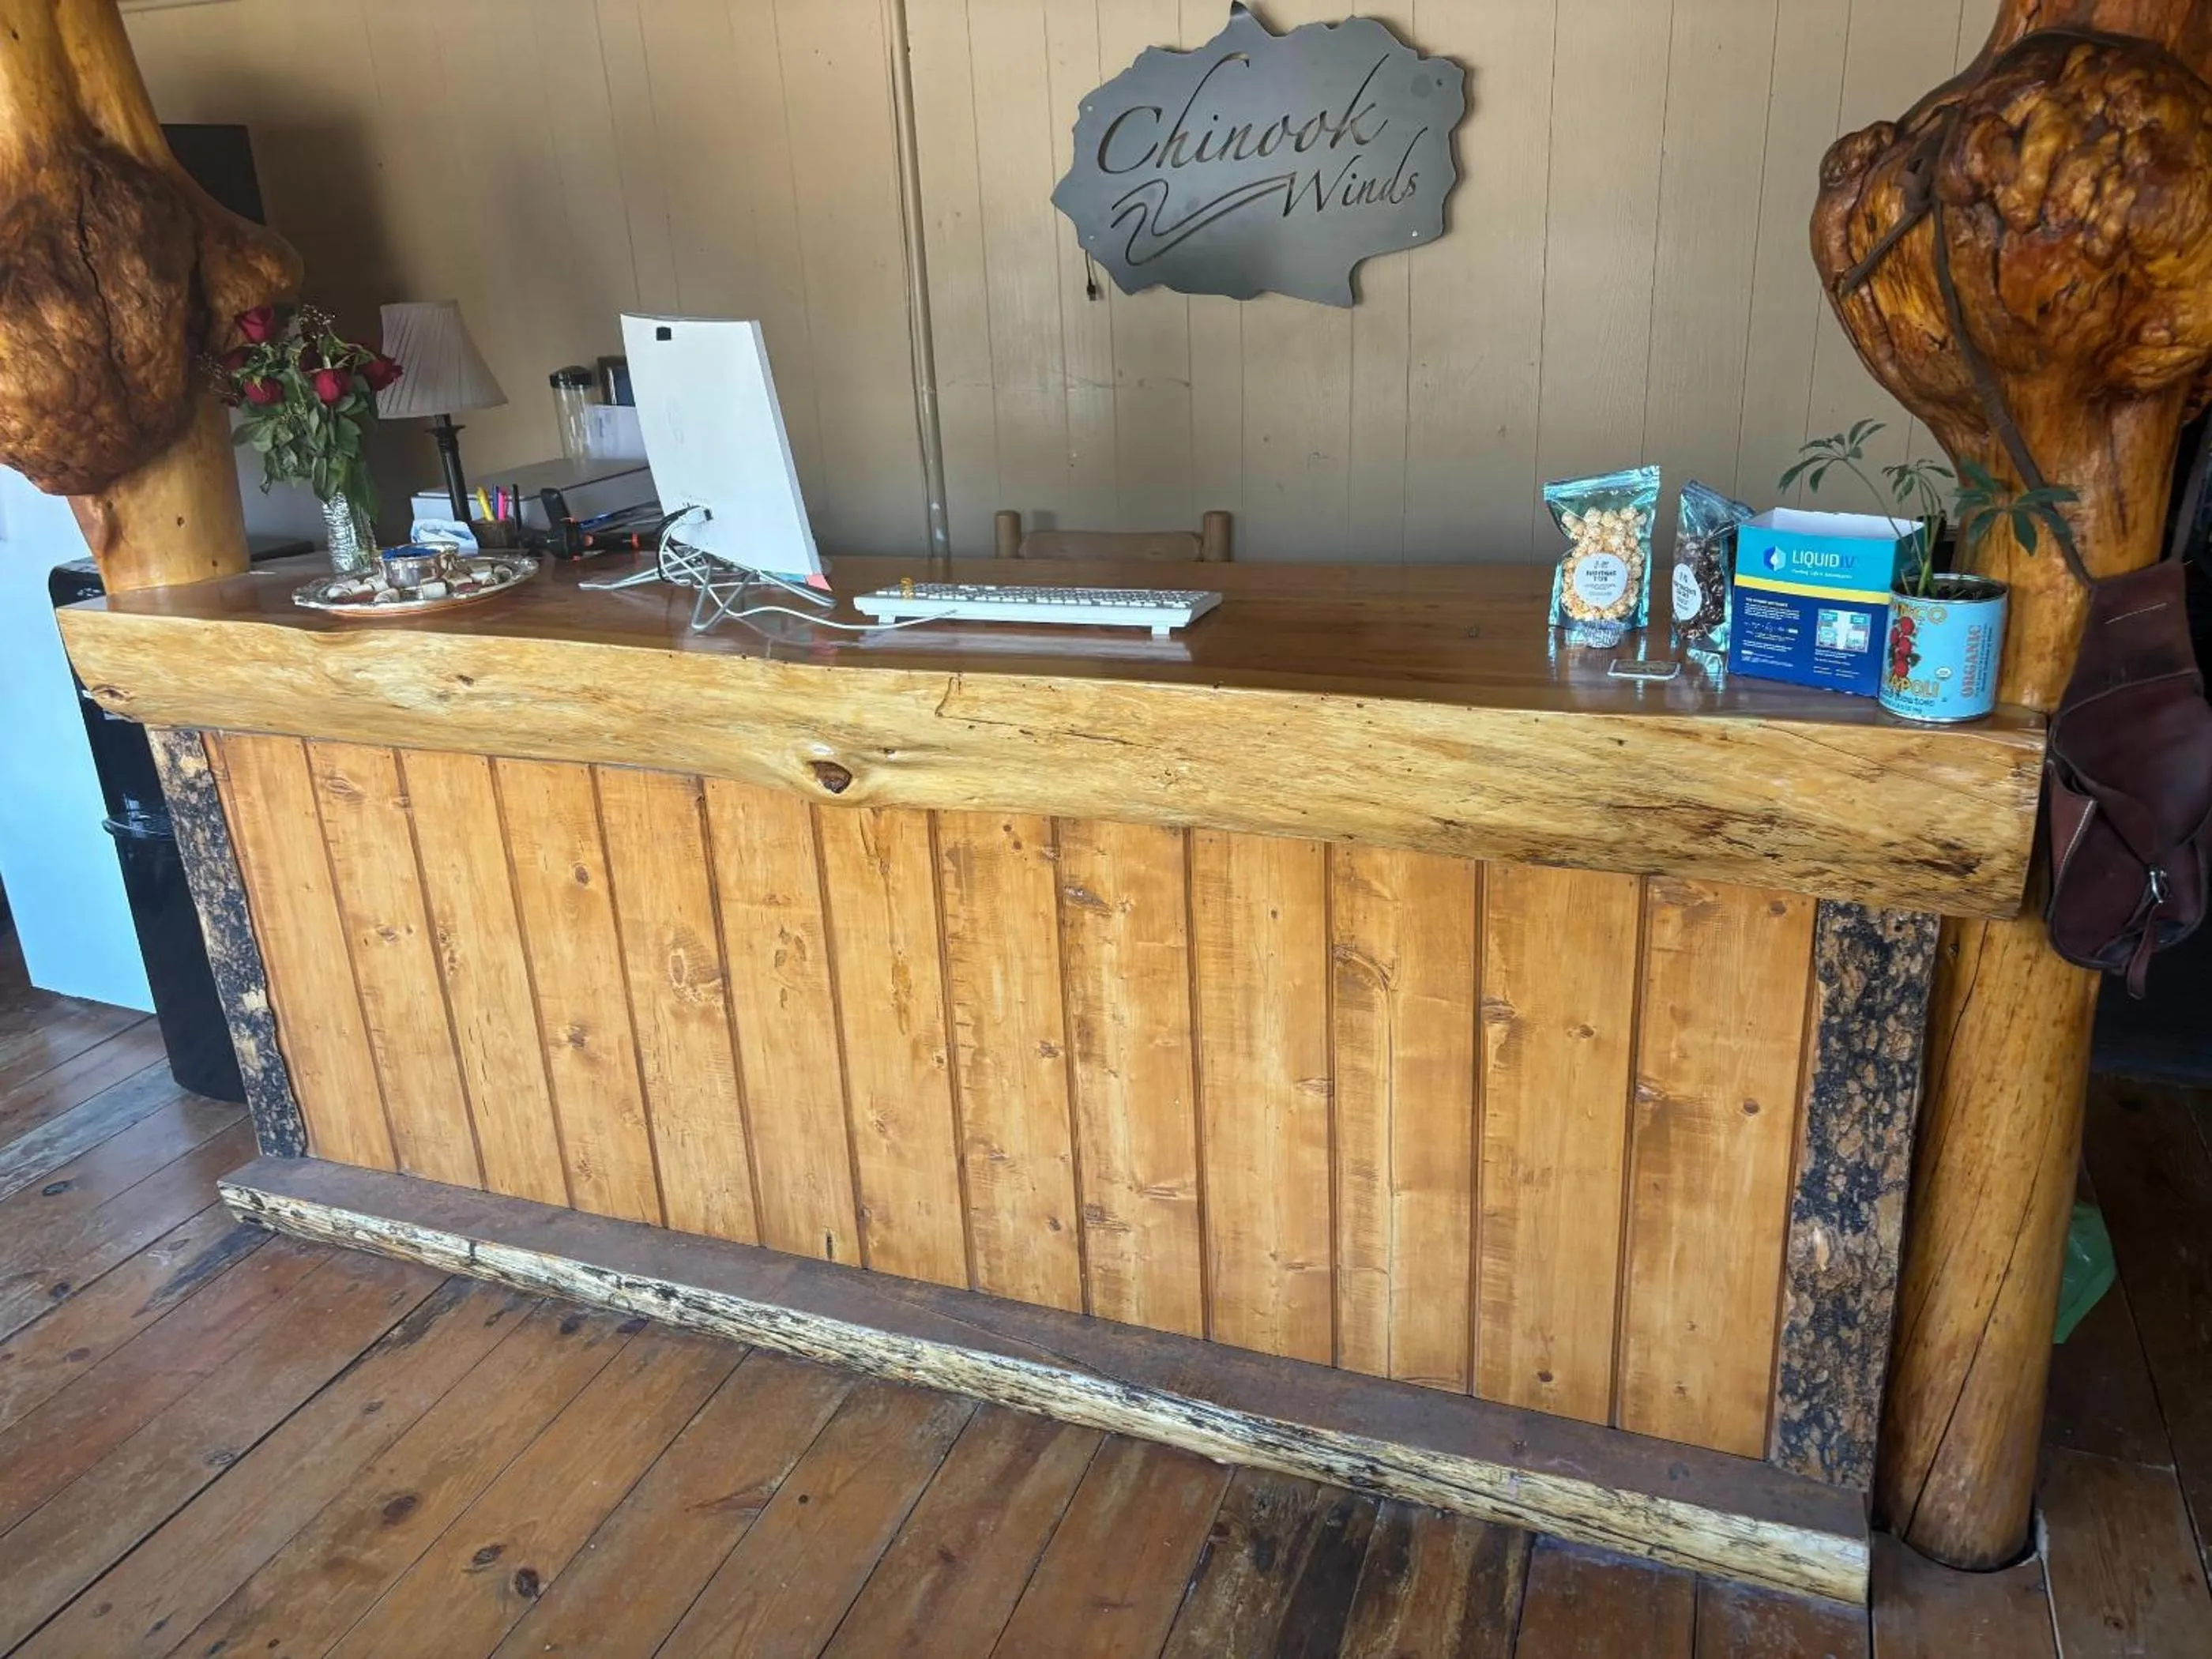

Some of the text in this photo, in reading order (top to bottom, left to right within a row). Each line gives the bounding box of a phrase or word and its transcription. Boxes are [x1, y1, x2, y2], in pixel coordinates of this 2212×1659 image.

[1097, 52, 1389, 175] Chinook
[1282, 127, 1428, 218] Winds
[1961, 625, 1982, 698] ORGANIC
